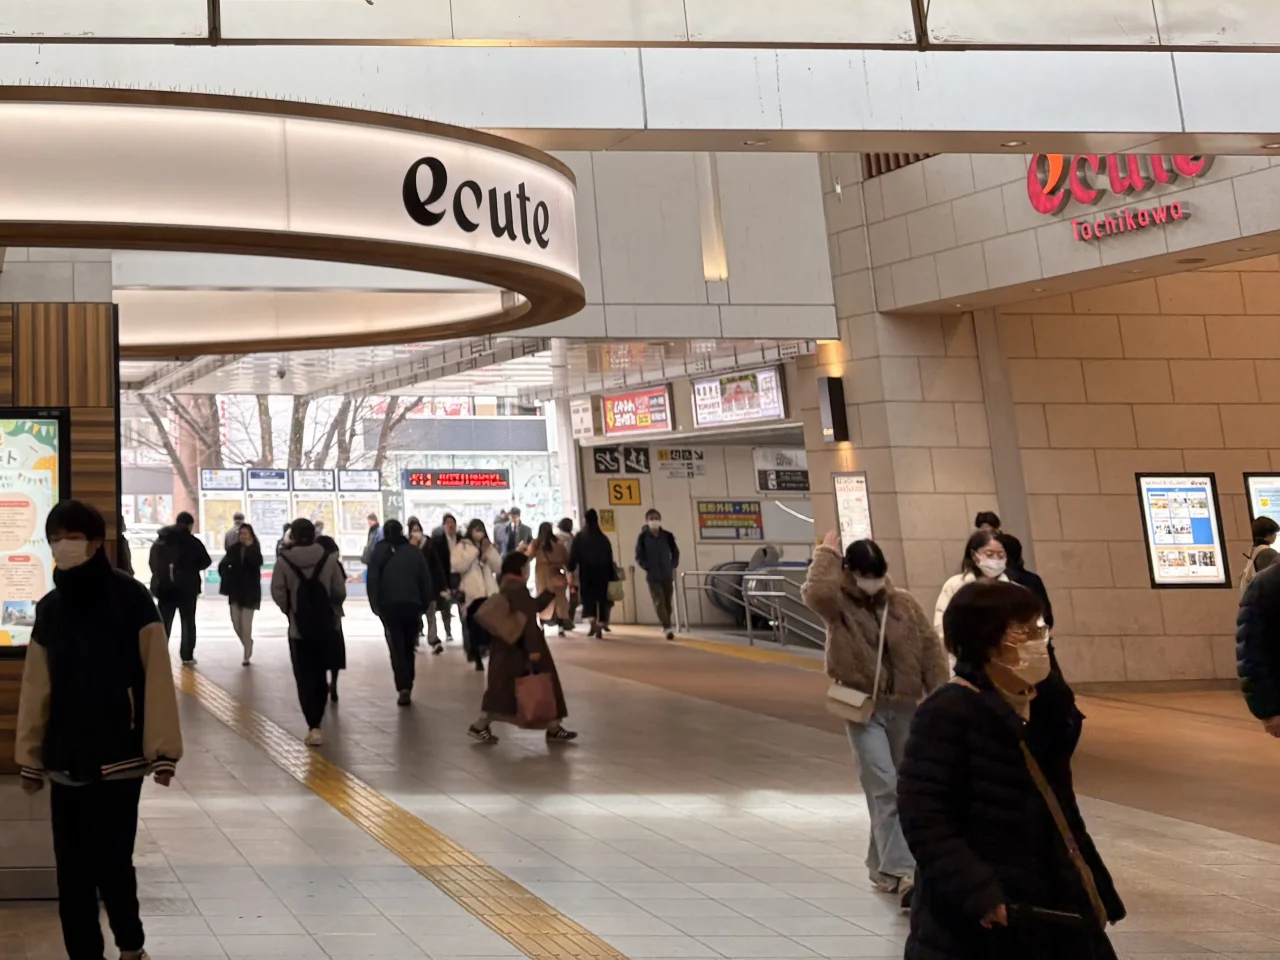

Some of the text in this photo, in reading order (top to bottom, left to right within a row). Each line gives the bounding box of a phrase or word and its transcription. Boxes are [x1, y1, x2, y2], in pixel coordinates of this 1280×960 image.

[402, 156, 550, 249] ecute
[1071, 200, 1183, 241] Tachikawa
[613, 483, 633, 501] S1
